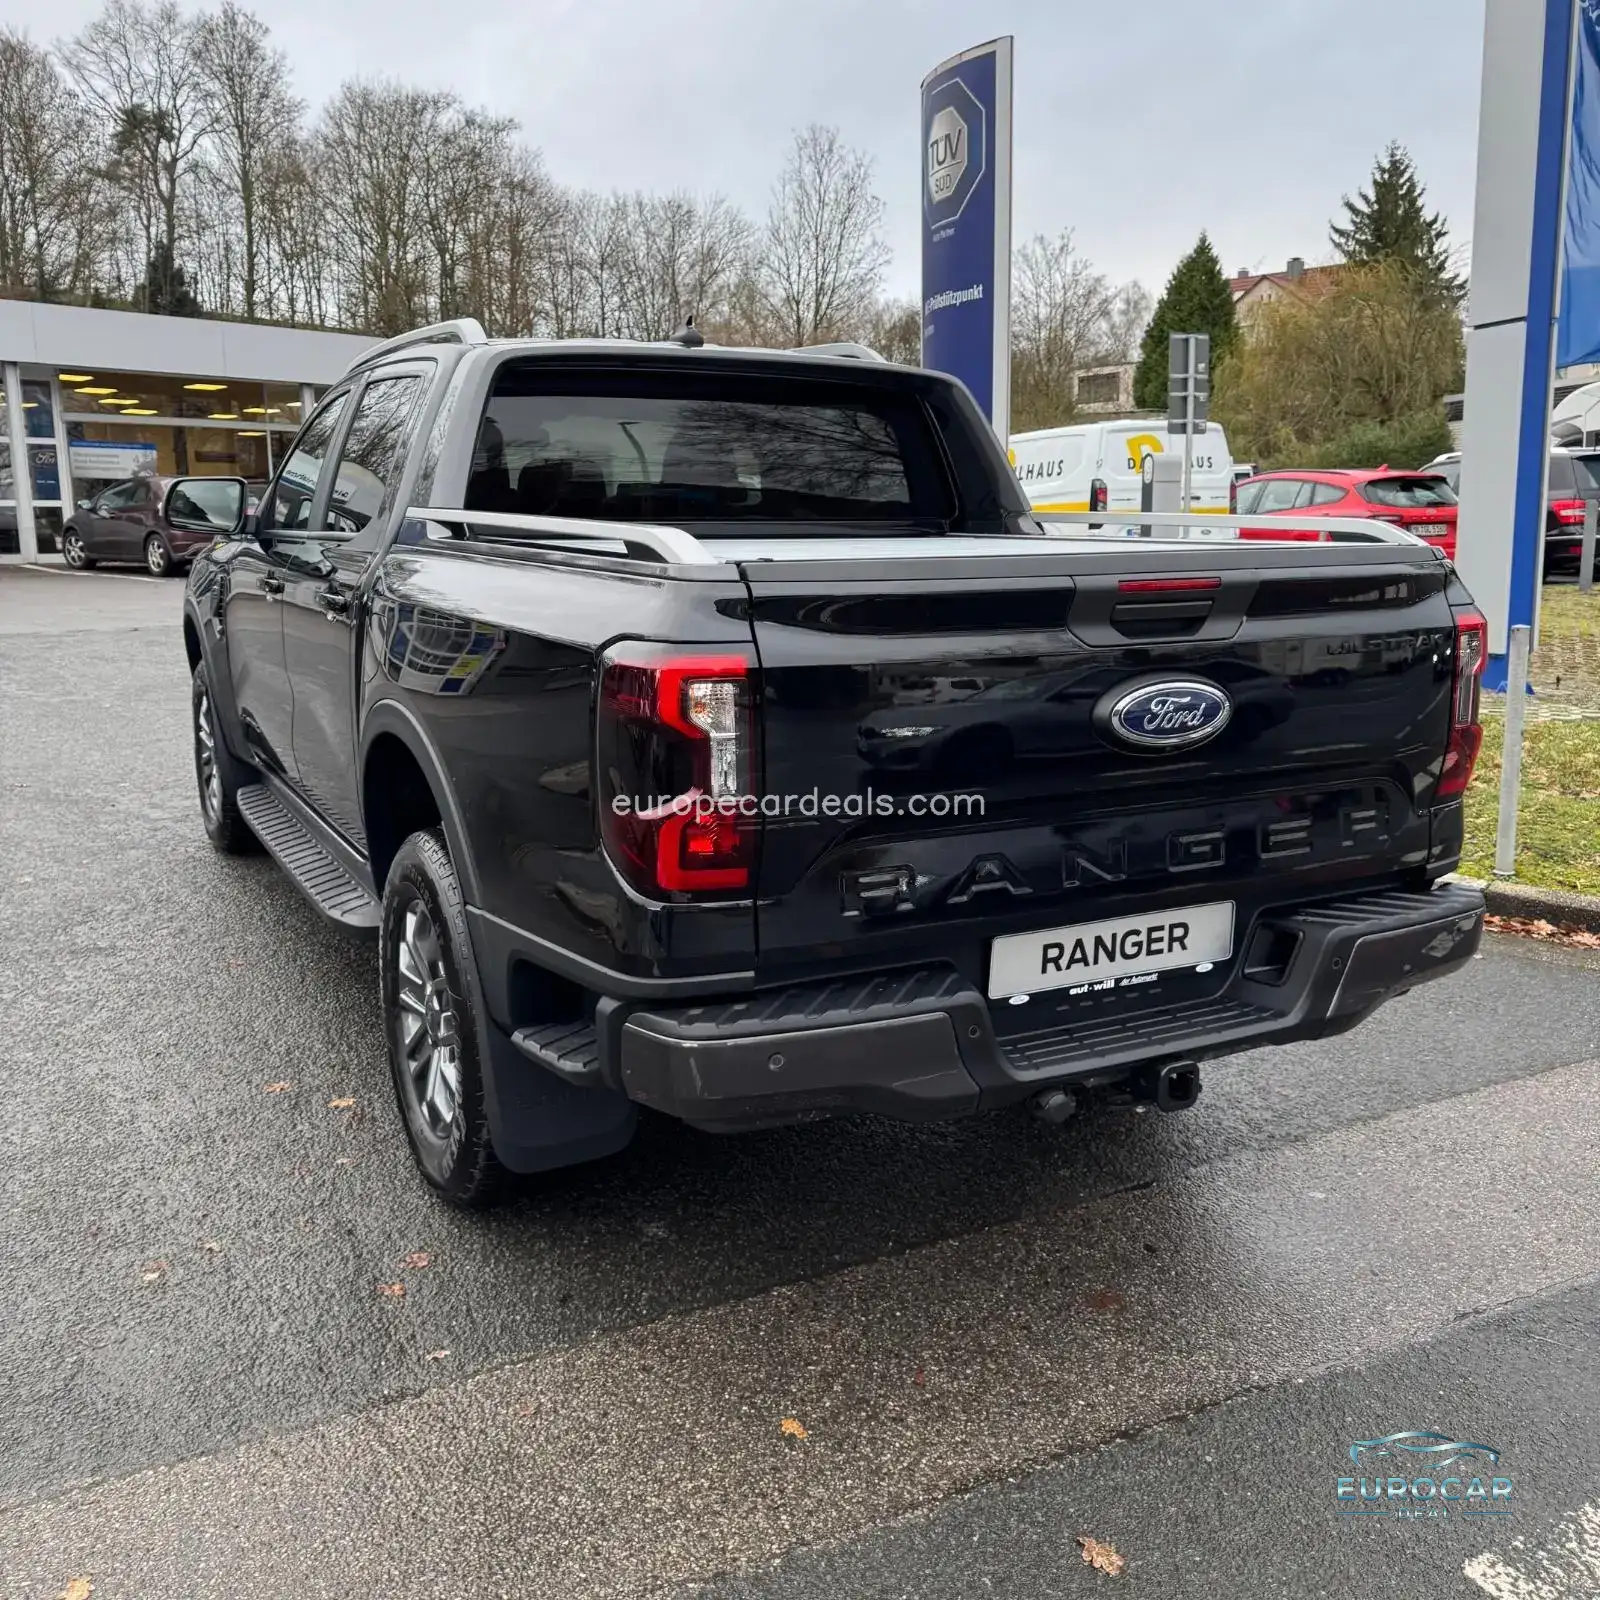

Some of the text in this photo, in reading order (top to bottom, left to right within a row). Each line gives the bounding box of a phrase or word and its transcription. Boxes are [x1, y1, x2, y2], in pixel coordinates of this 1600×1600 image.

[930, 127, 962, 170] TÜV
[1143, 696, 1206, 730] Ford
[838, 807, 1391, 918] RANGER
[1040, 921, 1190, 975] RANGER
